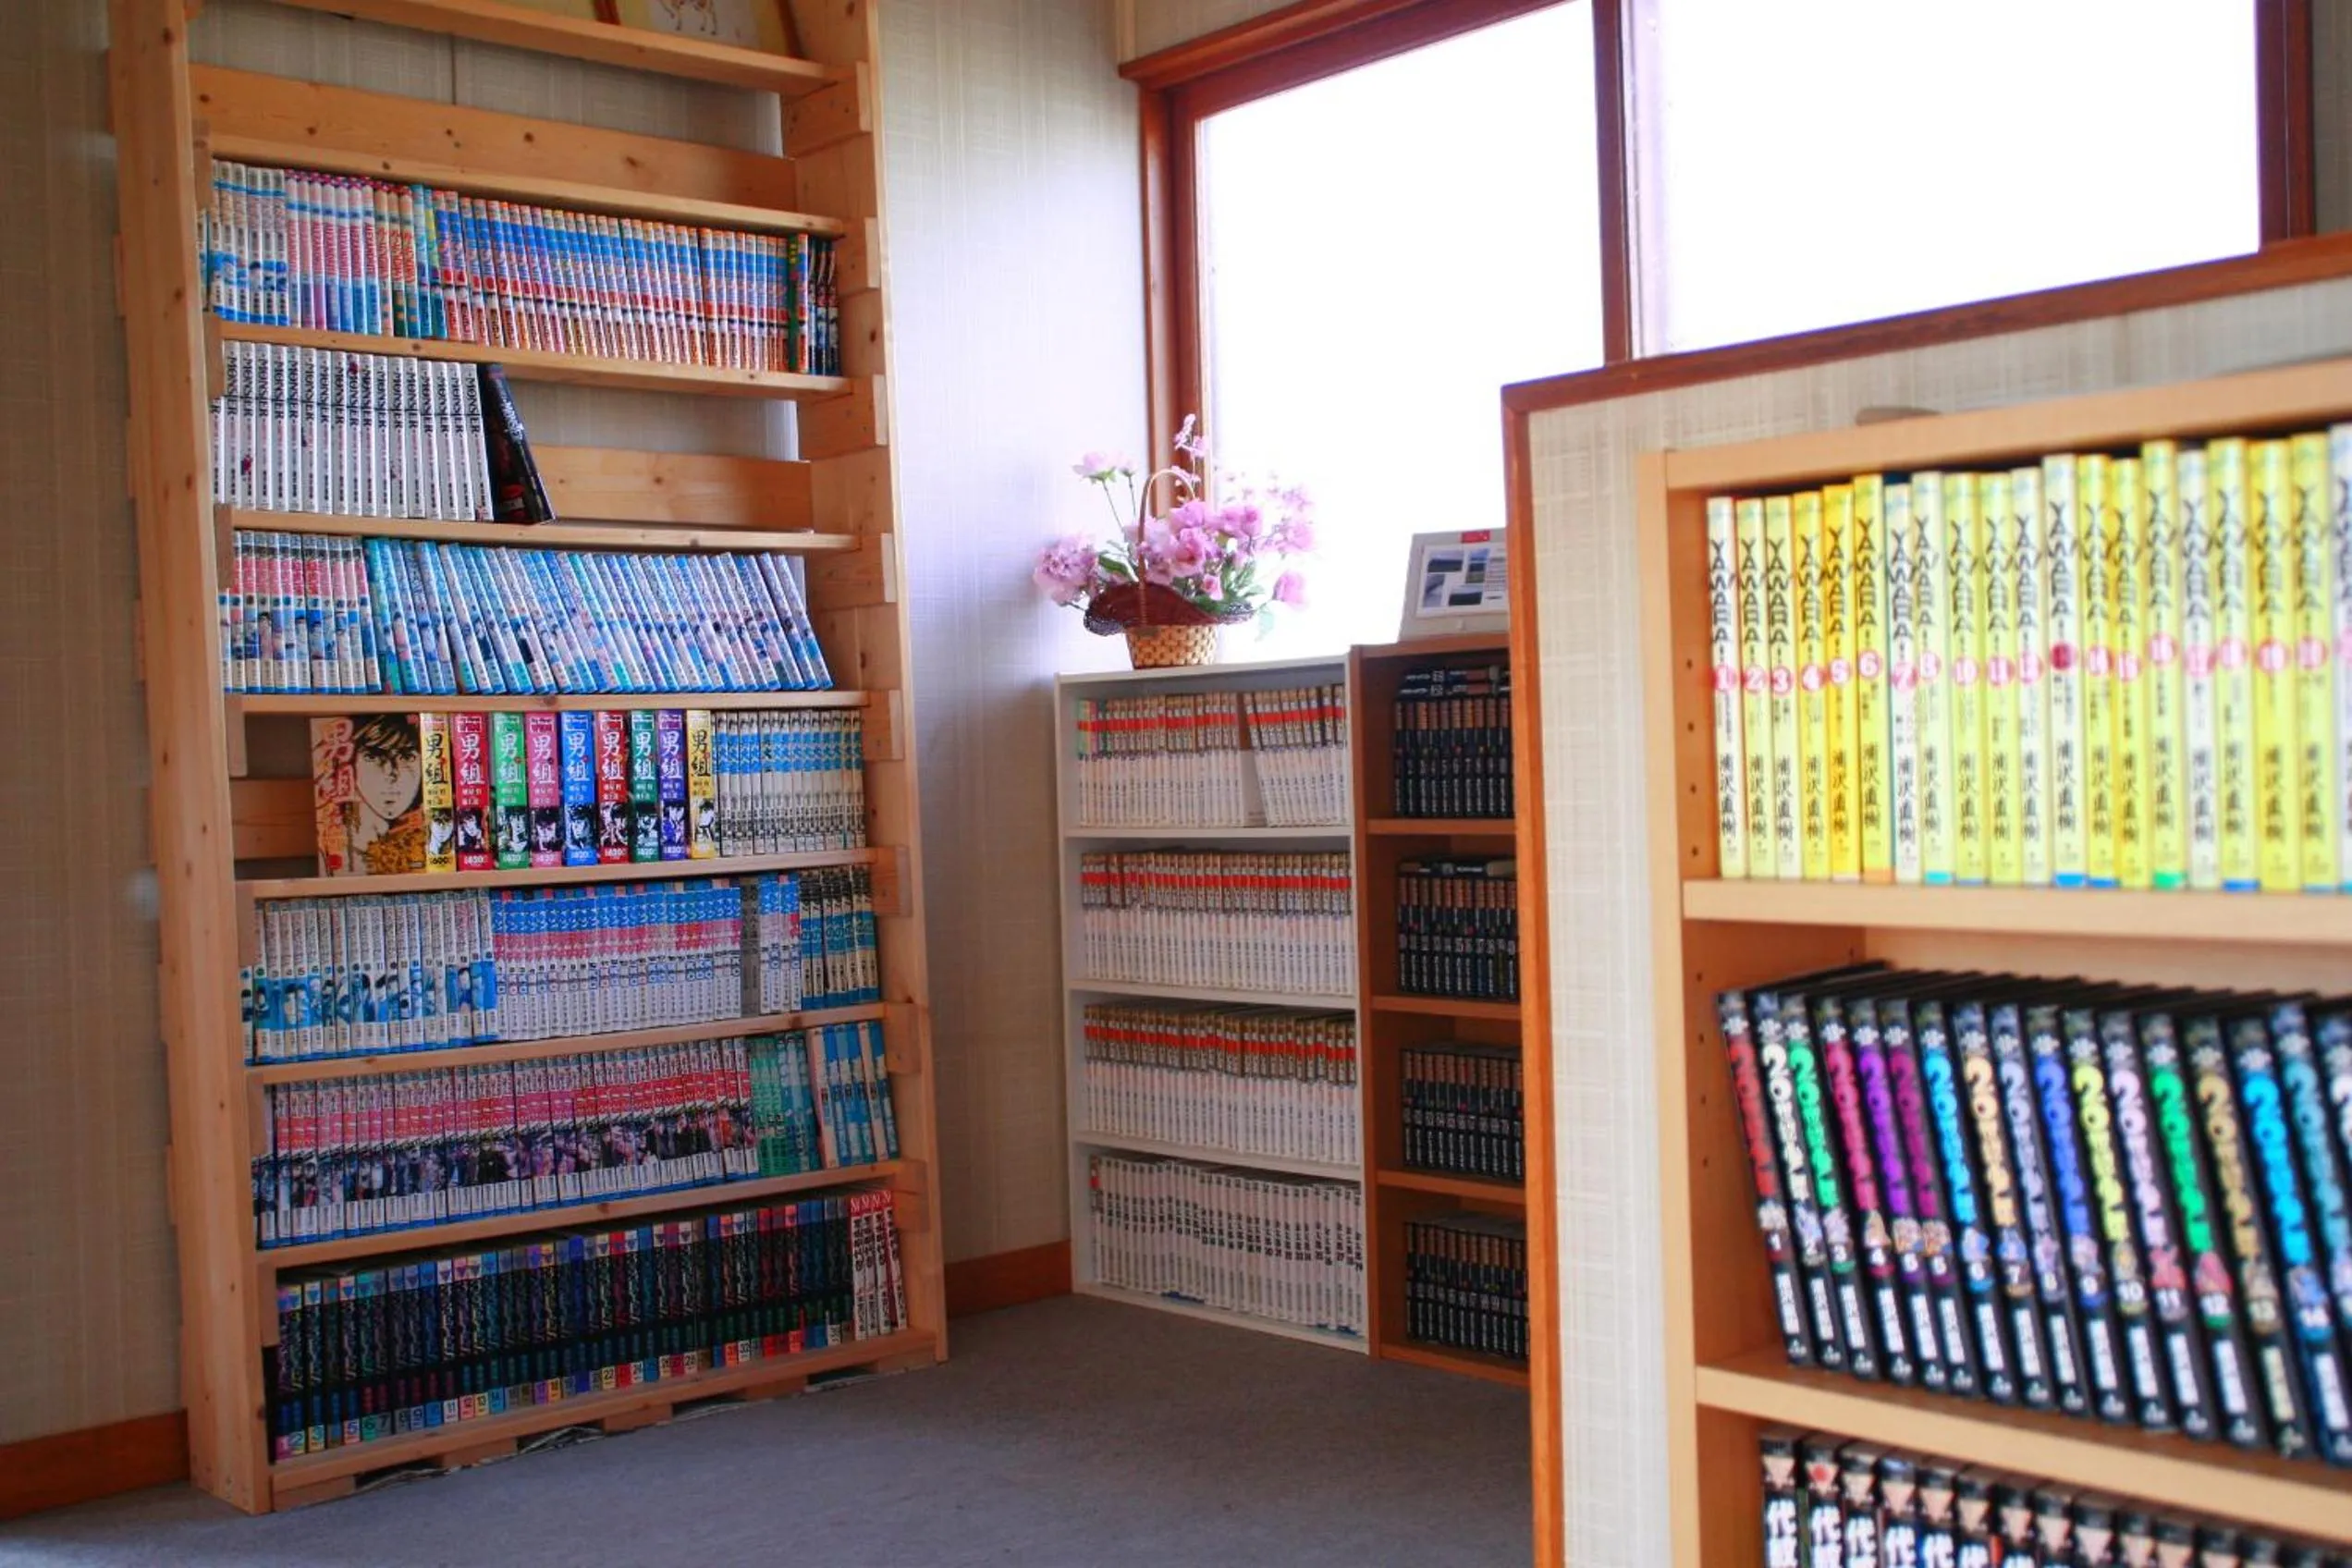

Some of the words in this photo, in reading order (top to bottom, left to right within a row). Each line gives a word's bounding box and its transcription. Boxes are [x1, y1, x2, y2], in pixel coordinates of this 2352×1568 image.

[425, 733, 447, 784] 男組
[459, 734, 484, 784] 男組
[499, 733, 523, 784] 男組
[533, 735, 556, 784] 男組
[567, 732, 589, 781] 男組
[602, 731, 624, 780] 男組
[634, 731, 655, 779] 男組
[661, 731, 682, 778] 男組
[692, 729, 711, 777] 男組
[1770, 1232, 1782, 1251] 1
[1834, 1243, 1847, 1263] 3
[2007, 1265, 2020, 1284] 7
[2117, 1280, 2144, 1301] 10
[2155, 1290, 2181, 1308] 11
